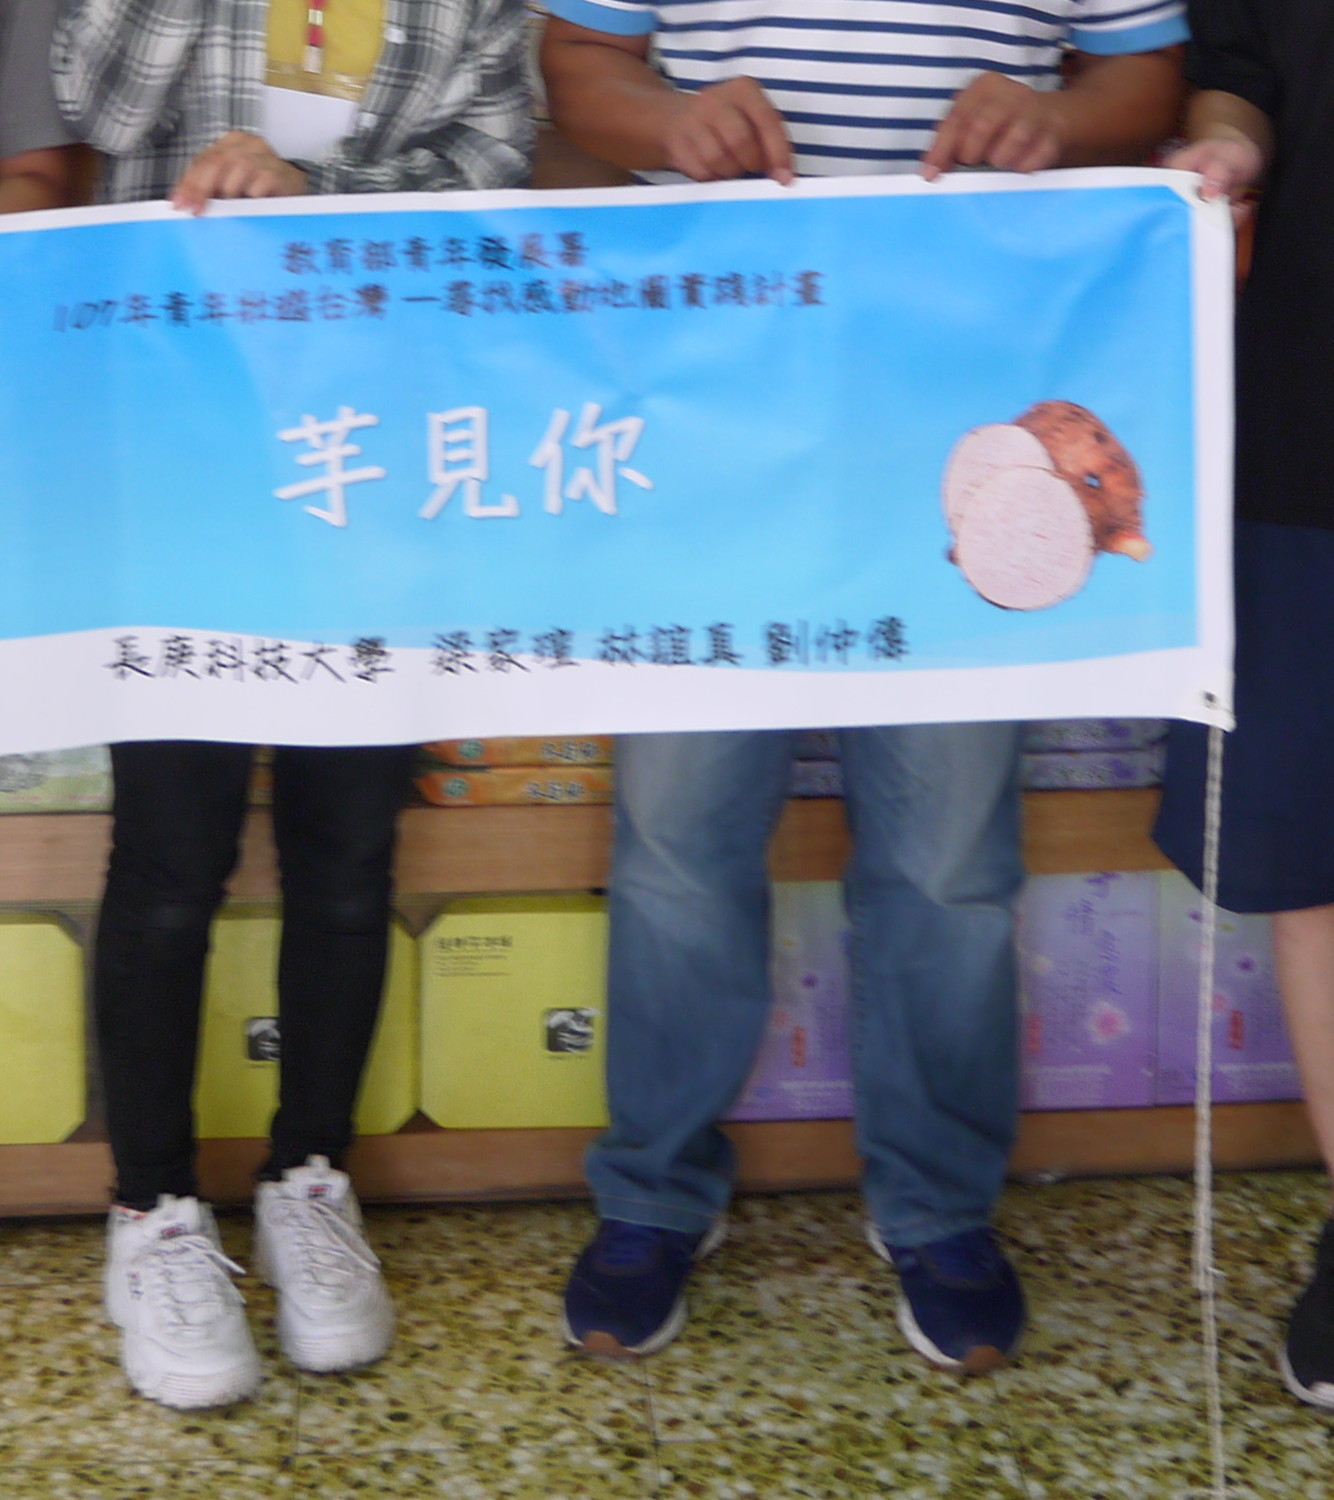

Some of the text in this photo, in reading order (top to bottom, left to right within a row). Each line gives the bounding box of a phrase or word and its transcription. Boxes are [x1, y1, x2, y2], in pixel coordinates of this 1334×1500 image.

[272, 401, 654, 529] 芋見你
[101, 633, 396, 684] 長庚科技大學
